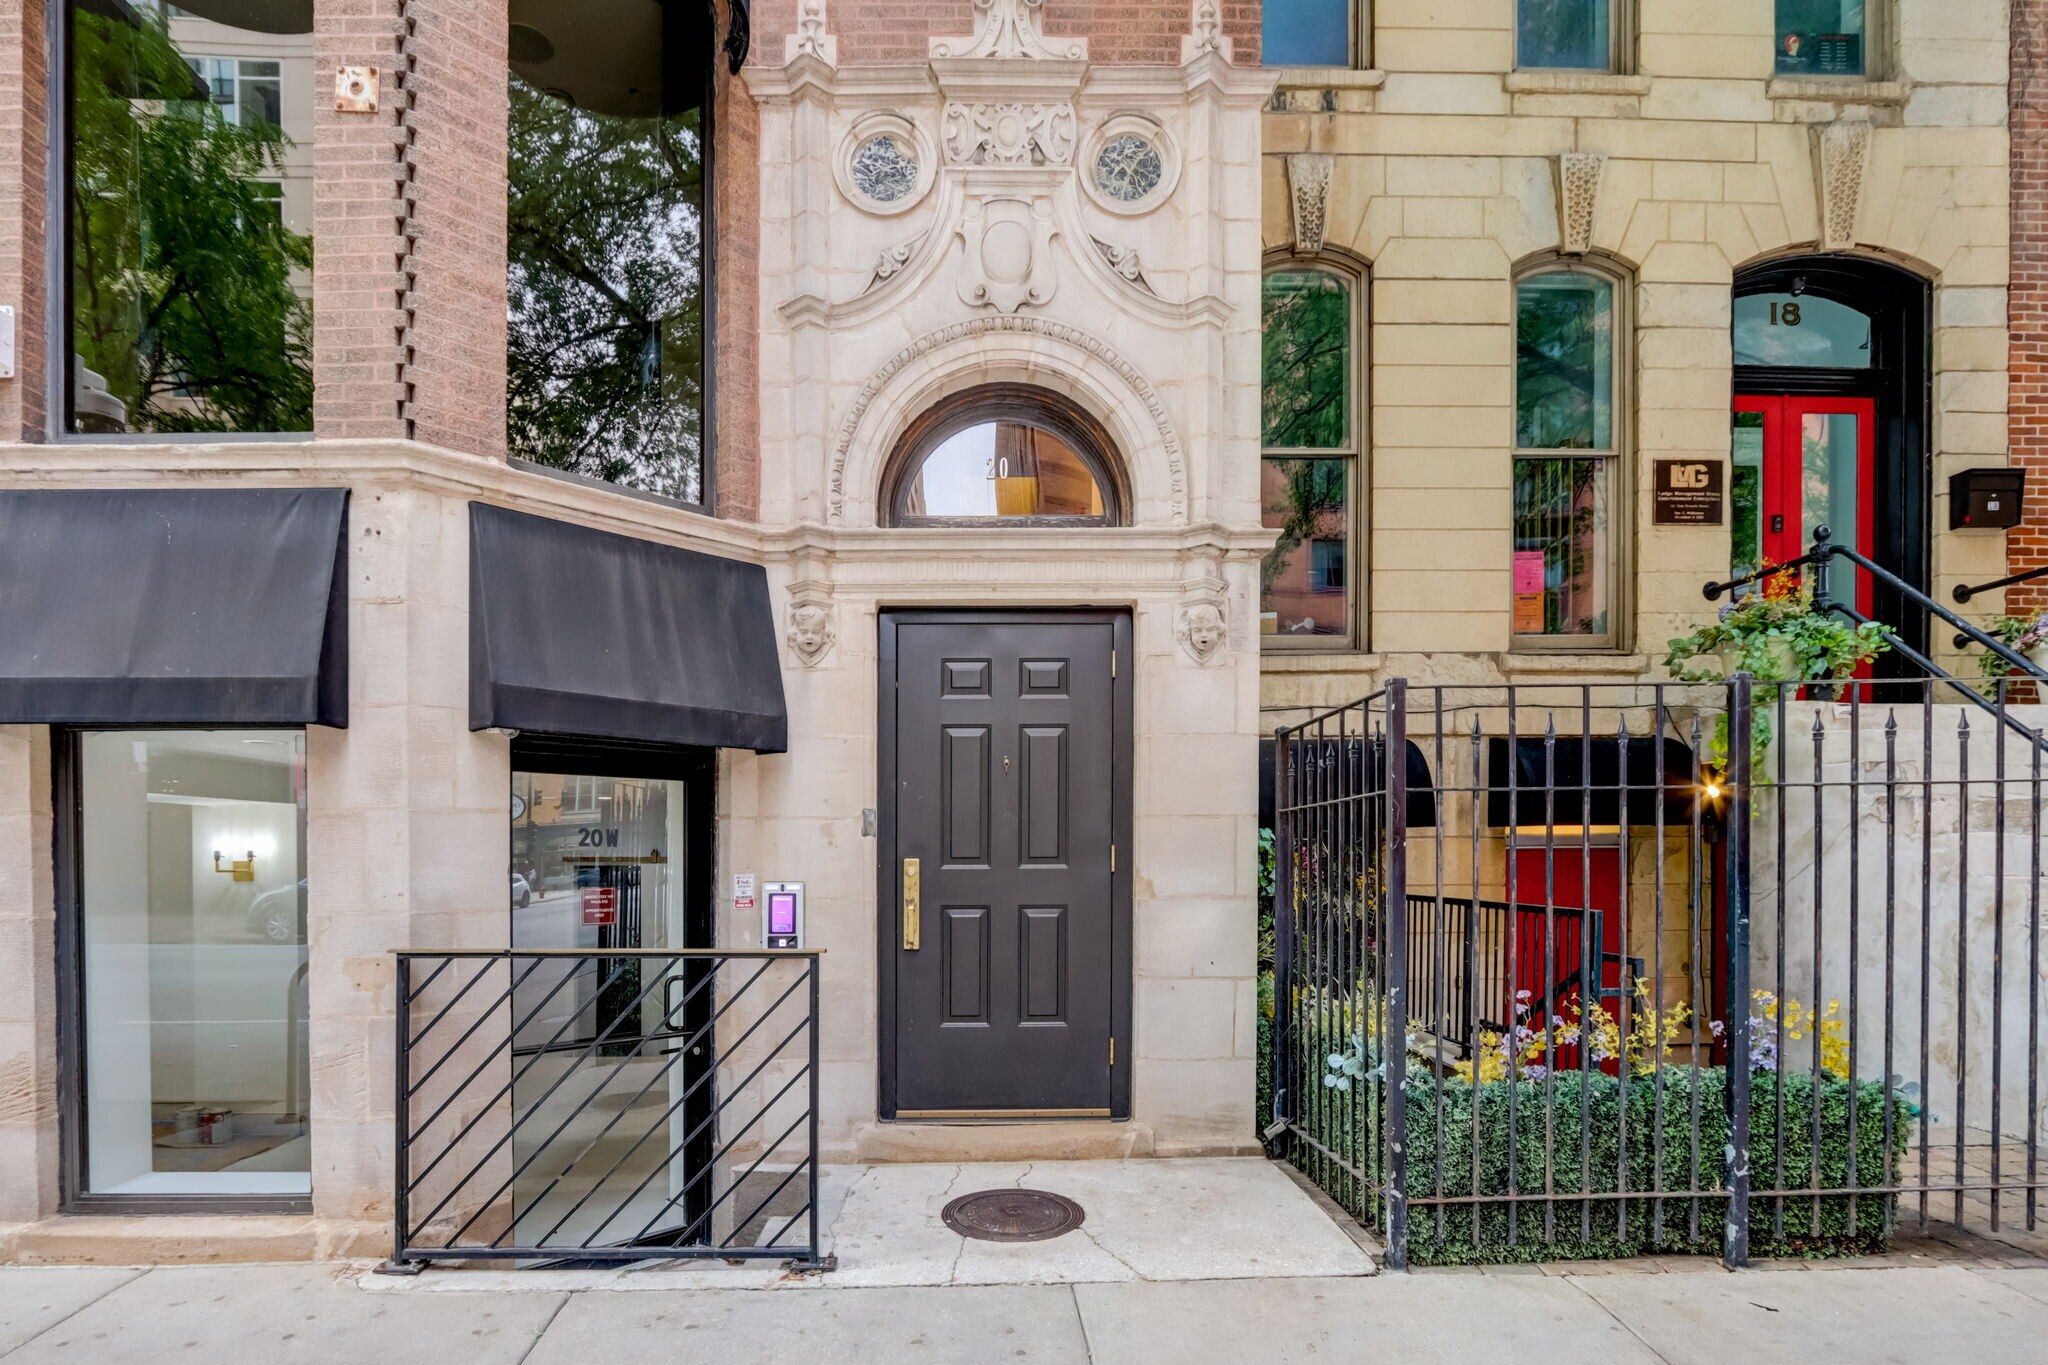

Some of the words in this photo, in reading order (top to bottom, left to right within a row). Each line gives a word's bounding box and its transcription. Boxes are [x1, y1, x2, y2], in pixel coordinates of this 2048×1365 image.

[1770, 302, 1801, 326] 18
[986, 457, 1008, 480] 20
[578, 827, 603, 847] 20
[606, 829, 619, 848] W
